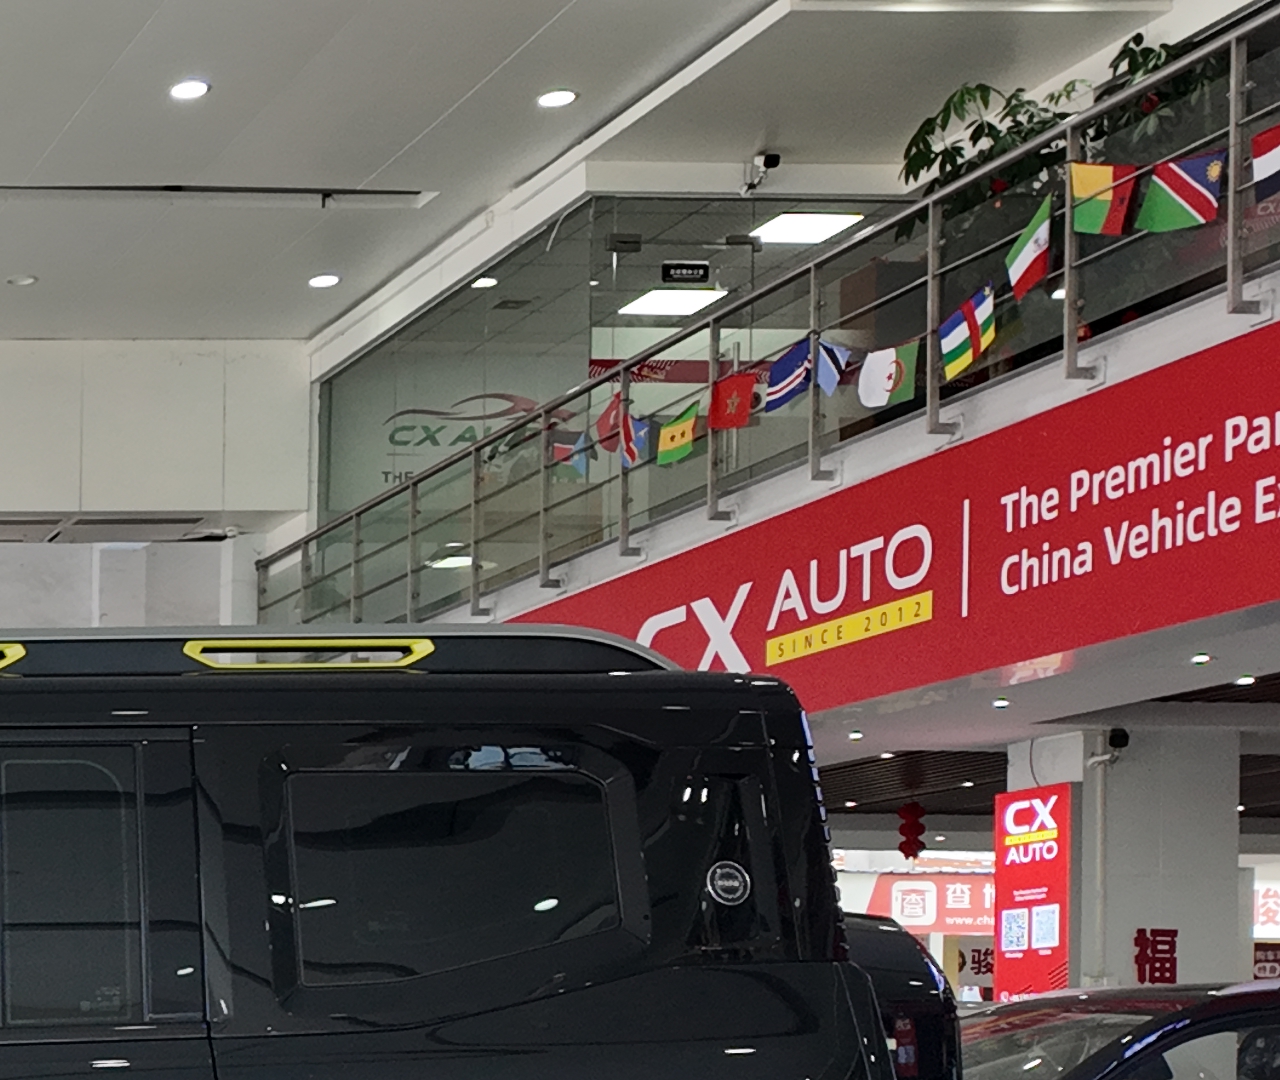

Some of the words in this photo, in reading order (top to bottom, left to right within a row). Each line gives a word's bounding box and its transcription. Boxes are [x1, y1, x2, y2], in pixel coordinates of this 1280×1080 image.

[388, 425, 447, 446] CX
[1000, 486, 1060, 533] The
[1070, 433, 1214, 513] Premier
[1001, 541, 1093, 595] China
[1103, 490, 1242, 566] Vehicle
[1255, 475, 1280, 524] E
[766, 524, 933, 632] AUTO
[777, 624, 844, 658] SINCE
[863, 601, 923, 634] 2012
[1004, 795, 1058, 834] CX
[1004, 840, 1058, 866] AUTO
[1134, 928, 1178, 984] 福
